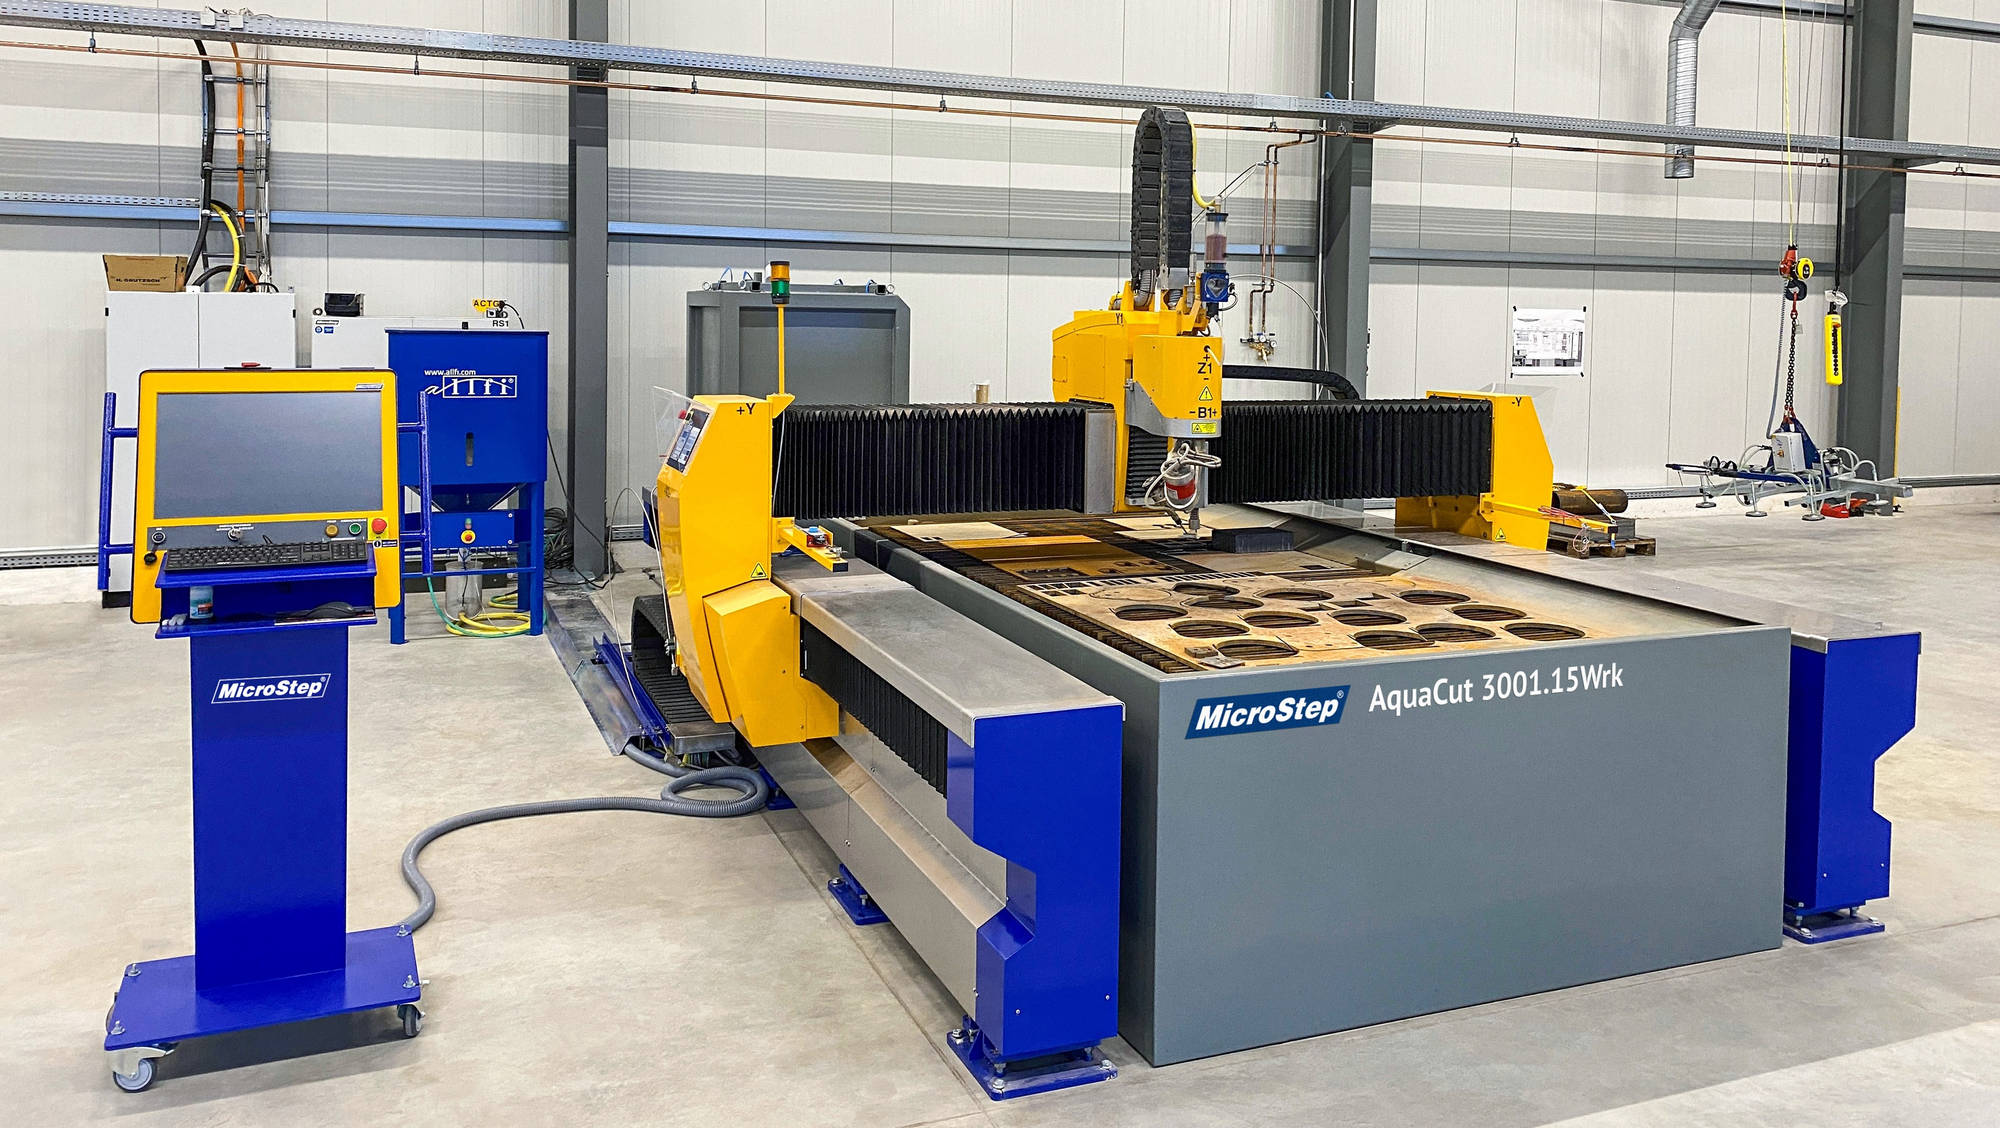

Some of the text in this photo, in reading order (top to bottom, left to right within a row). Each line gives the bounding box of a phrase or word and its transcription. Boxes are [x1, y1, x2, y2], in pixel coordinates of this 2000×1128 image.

[492, 319, 509, 327] RS1
[424, 368, 476, 376] www.allfi.com
[1197, 362, 1212, 374] Z1
[1368, 662, 1624, 717] AquaCut 3001.15Wrk
